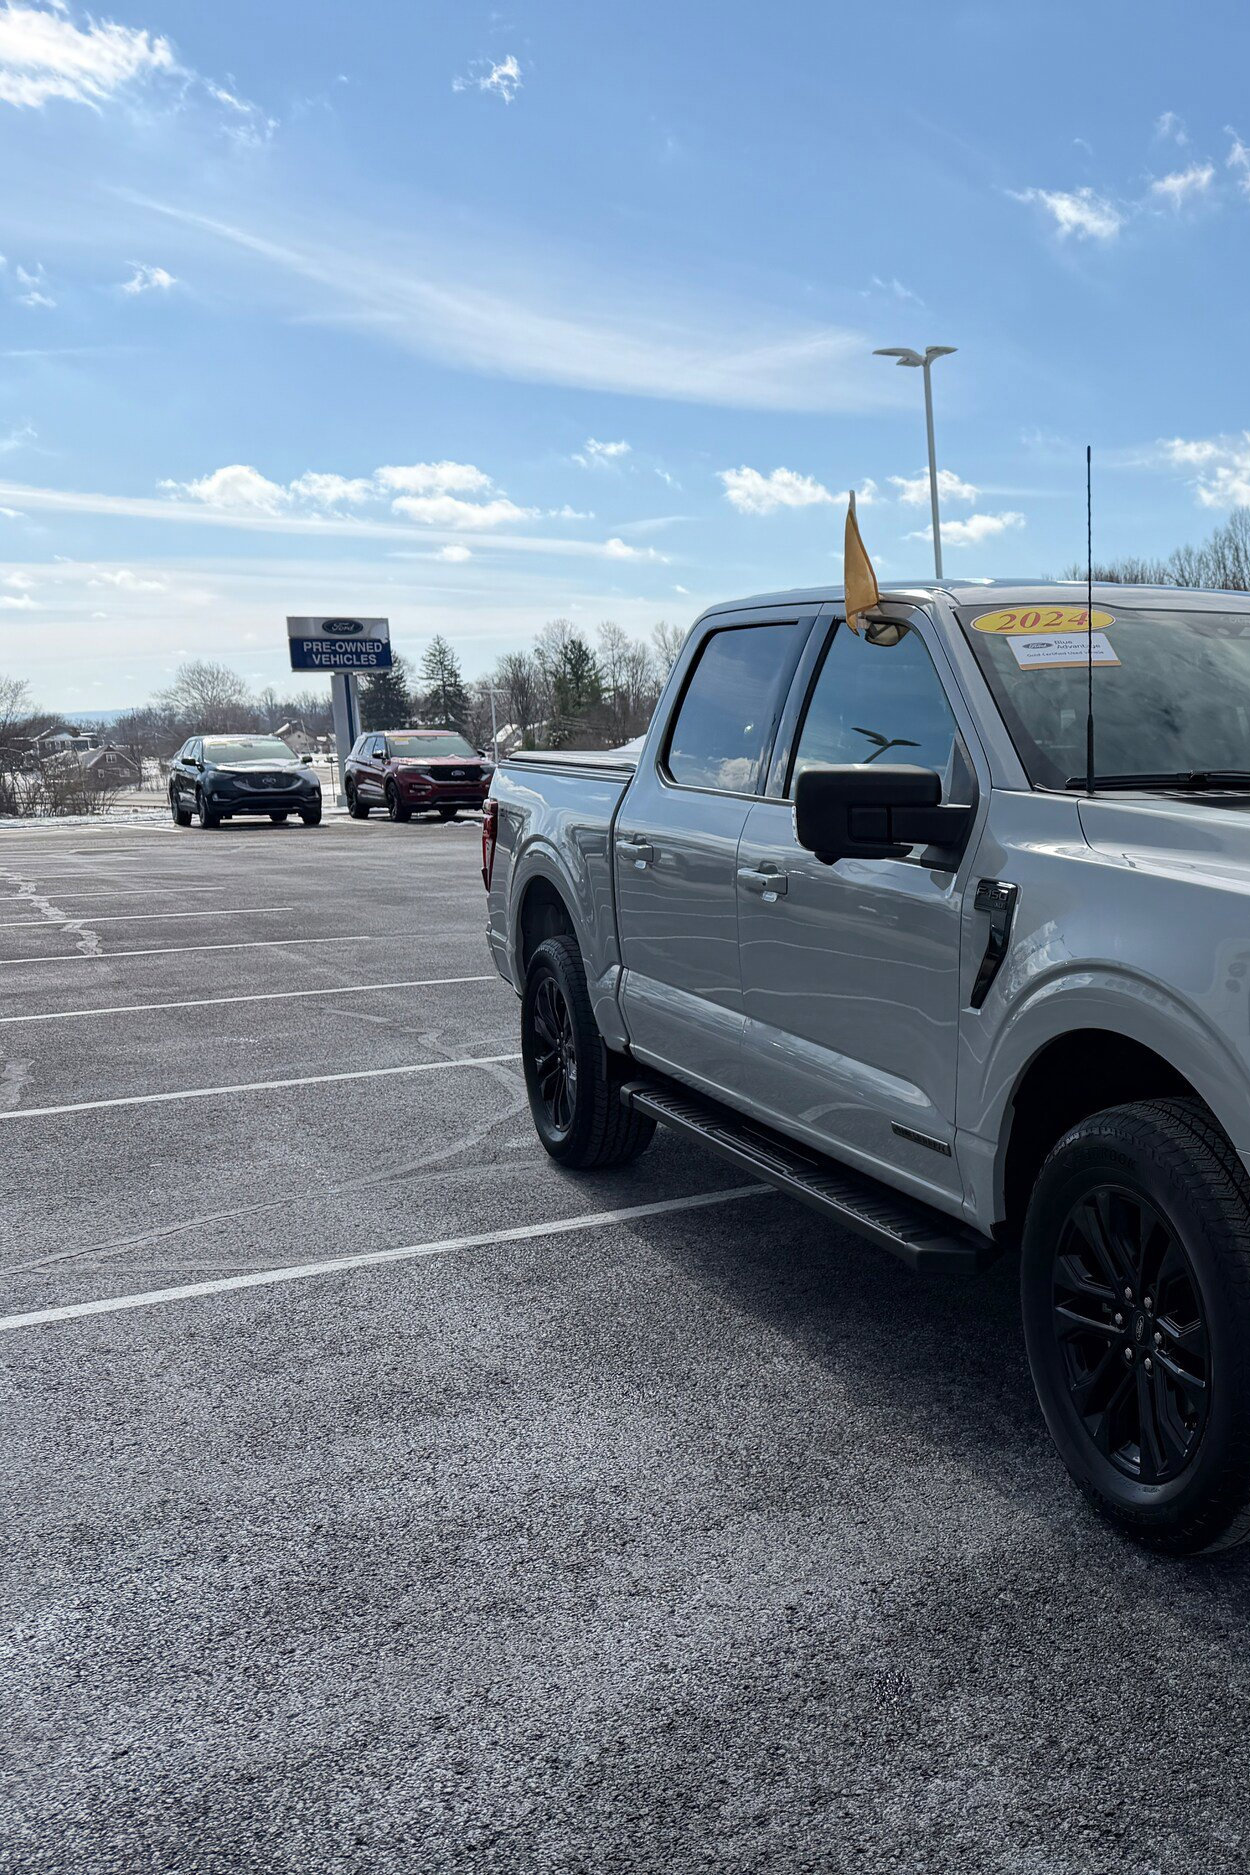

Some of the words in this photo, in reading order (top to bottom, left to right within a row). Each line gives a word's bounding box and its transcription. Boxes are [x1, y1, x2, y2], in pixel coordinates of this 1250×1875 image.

[996, 611, 1089, 630] 2024
[331, 622, 355, 632] Ford
[303, 641, 383, 653] PRE-OWNED
[312, 654, 377, 665] VEHICLES
